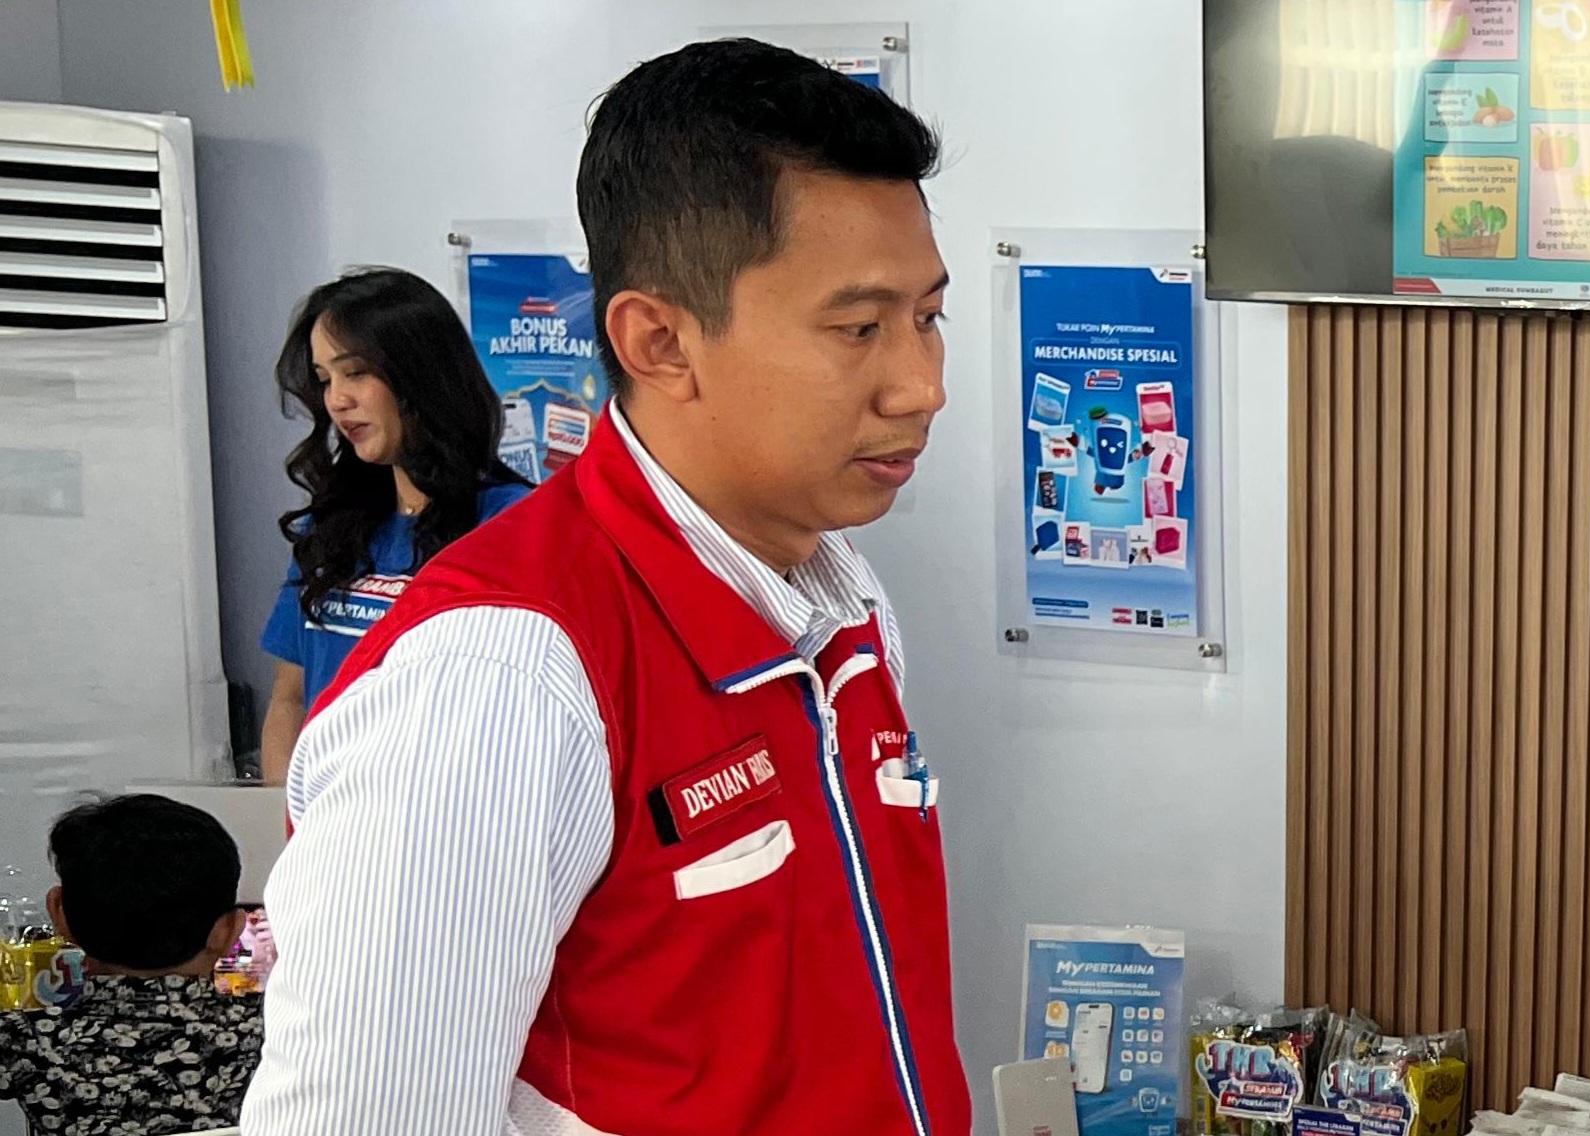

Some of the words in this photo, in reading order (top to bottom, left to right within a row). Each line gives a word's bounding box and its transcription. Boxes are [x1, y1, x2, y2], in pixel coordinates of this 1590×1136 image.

[510, 318, 567, 336] BONUS
[490, 337, 537, 356] AKHIR
[540, 337, 593, 358] PEKAN
[1034, 347, 1124, 361] MERCHANDISE
[1127, 349, 1178, 363] SPESIAL
[681, 763, 751, 818] DEVIAN
[1056, 960, 1155, 977] MyPERTAMINA
